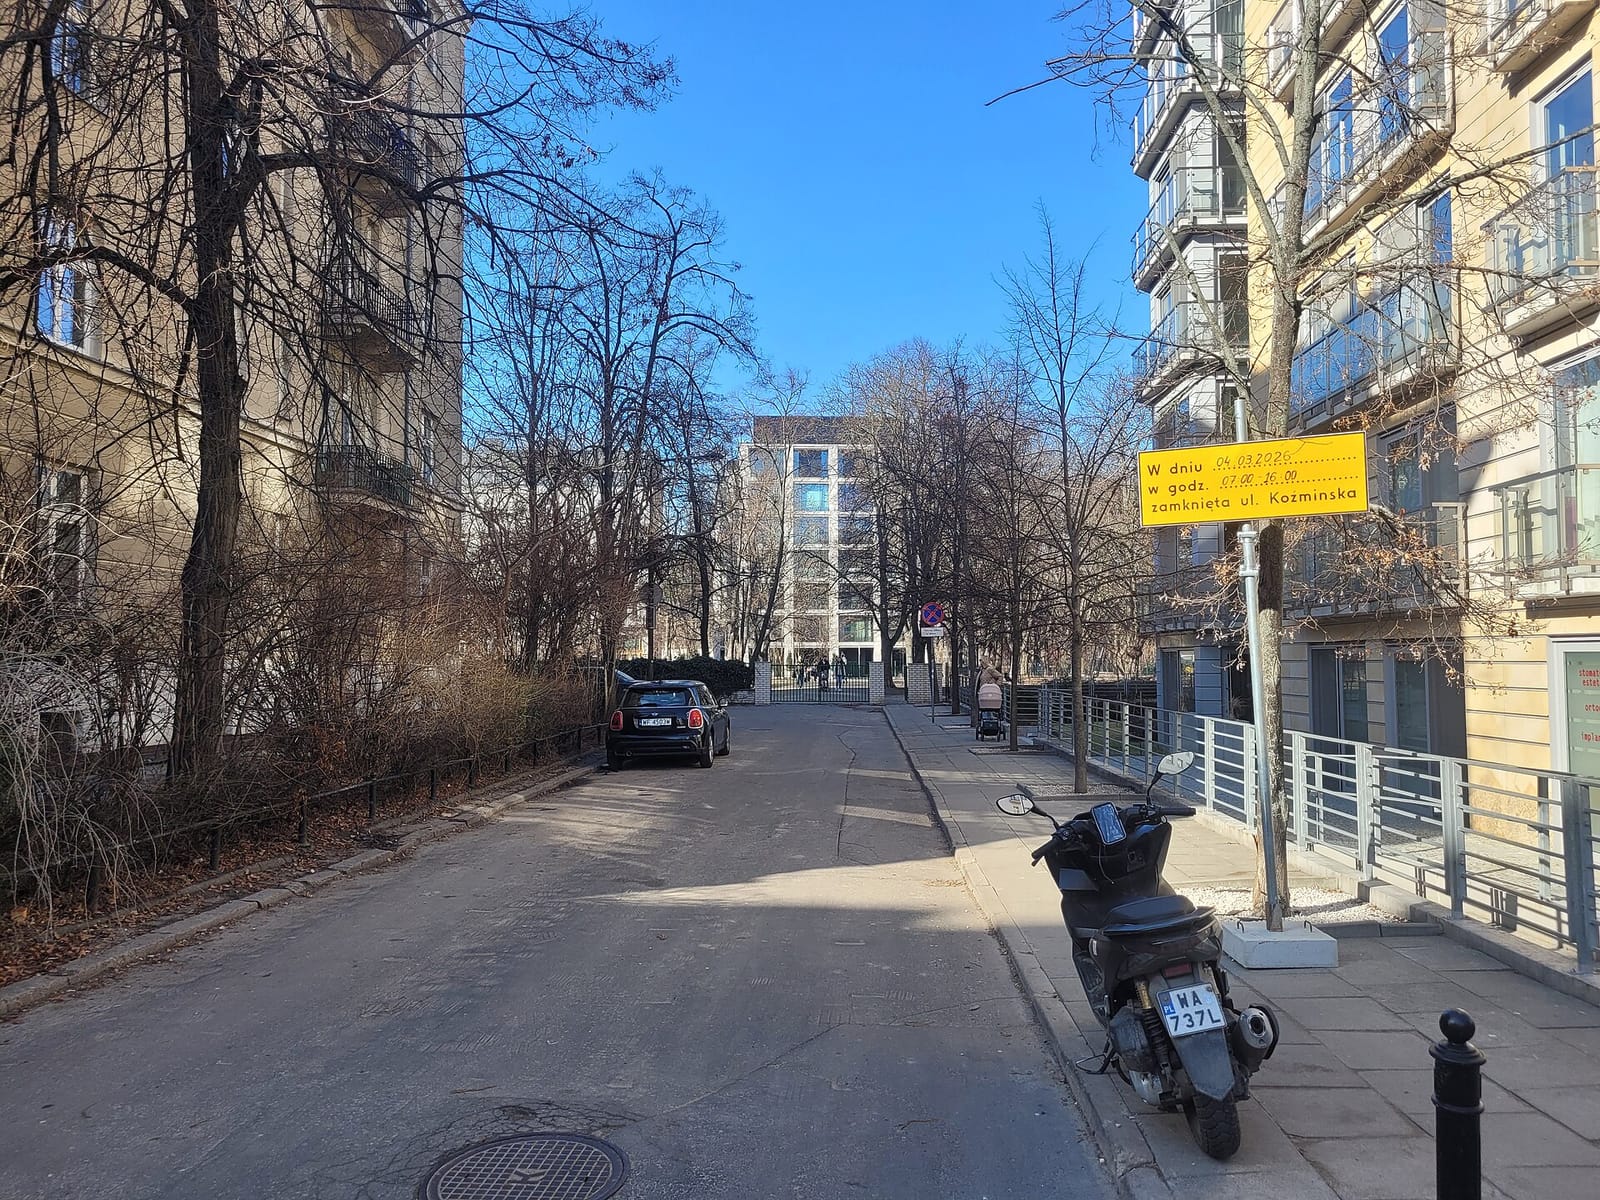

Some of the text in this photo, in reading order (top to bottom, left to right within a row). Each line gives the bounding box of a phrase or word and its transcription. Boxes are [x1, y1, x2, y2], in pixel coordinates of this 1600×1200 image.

[1147, 463, 1161, 476] W
[1169, 461, 1203, 475] dniu
[1148, 486, 1159, 495] w
[1168, 479, 1209, 496] godz.
[1151, 497, 1230, 513] zamknięta
[1240, 493, 1259, 506] ul.
[1578, 668, 1600, 677] stomat
[1177, 991, 1202, 1008] WA
[1163, 1005, 1175, 1014] PL
[1170, 1009, 1221, 1031] 737L
